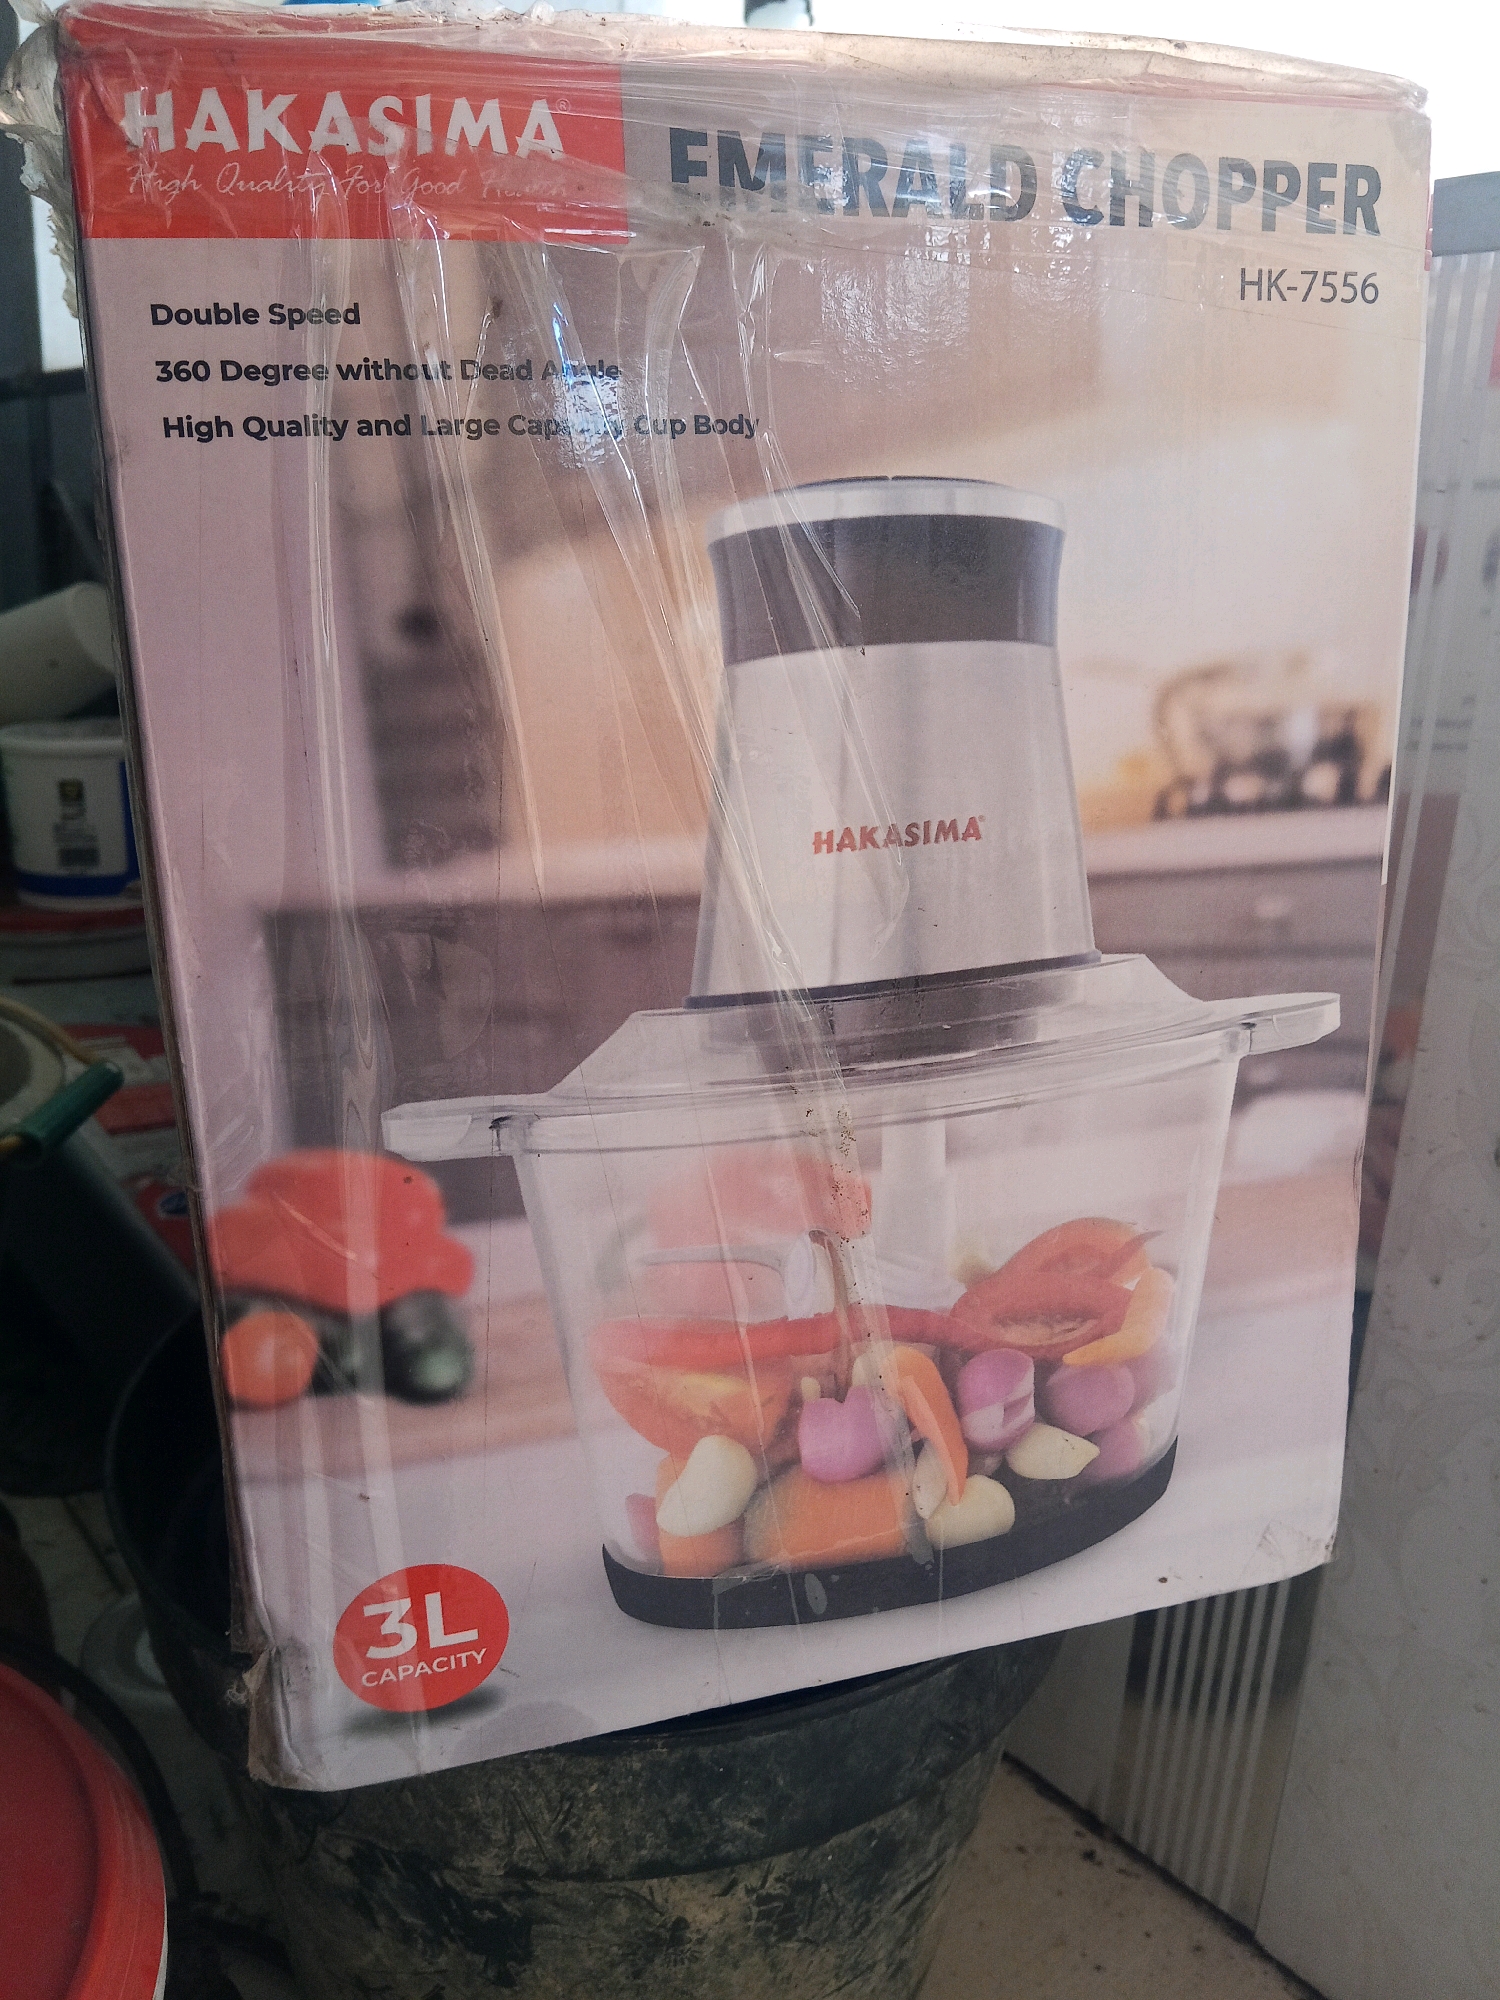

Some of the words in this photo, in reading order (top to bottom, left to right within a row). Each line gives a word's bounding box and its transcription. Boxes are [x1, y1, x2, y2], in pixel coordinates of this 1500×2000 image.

[123, 86, 566, 160] HAKASIMA
[127, 161, 200, 206] High
[217, 161, 326, 200] Quality
[339, 165, 386, 200] For
[401, 166, 468, 206] Good
[669, 127, 1038, 222] EMERALD
[1059, 146, 1382, 236] CHOPPER
[1240, 267, 1380, 304] HK-7556
[150, 303, 260, 326] Double
[268, 303, 361, 331] Speed
[155, 360, 210, 382] 360
[220, 360, 329, 388] Degree
[335, 359, 452, 382] without
[460, 359, 533, 382] Dead
[163, 414, 234, 442] High
[242, 414, 348, 440] Quality
[356, 413, 411, 437] and
[421, 413, 500, 440] Large
[634, 415, 687, 439] Cup
[694, 414, 759, 440] Body
[812, 816, 982, 854] HAKASIMA
[363, 1591, 479, 1659] 3L
[361, 1648, 487, 1688] CAPACITY
